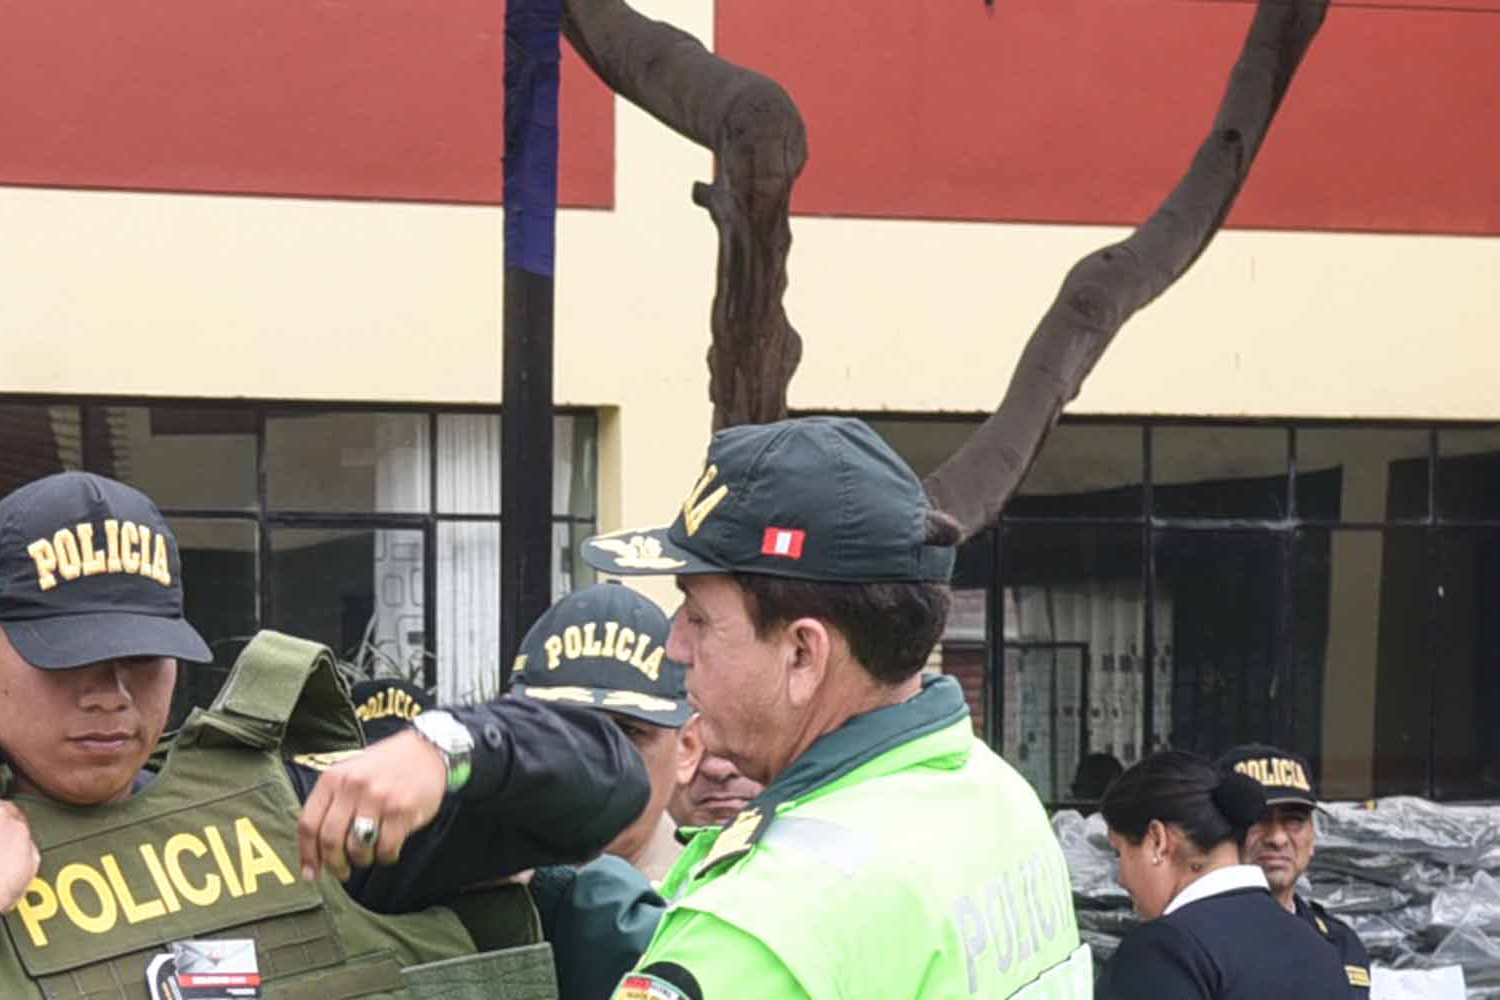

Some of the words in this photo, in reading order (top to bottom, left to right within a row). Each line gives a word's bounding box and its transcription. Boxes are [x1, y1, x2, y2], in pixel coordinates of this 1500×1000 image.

[27, 519, 172, 592] POLICIA
[544, 621, 666, 682] POLICIA
[16, 816, 296, 947] POLICIA
